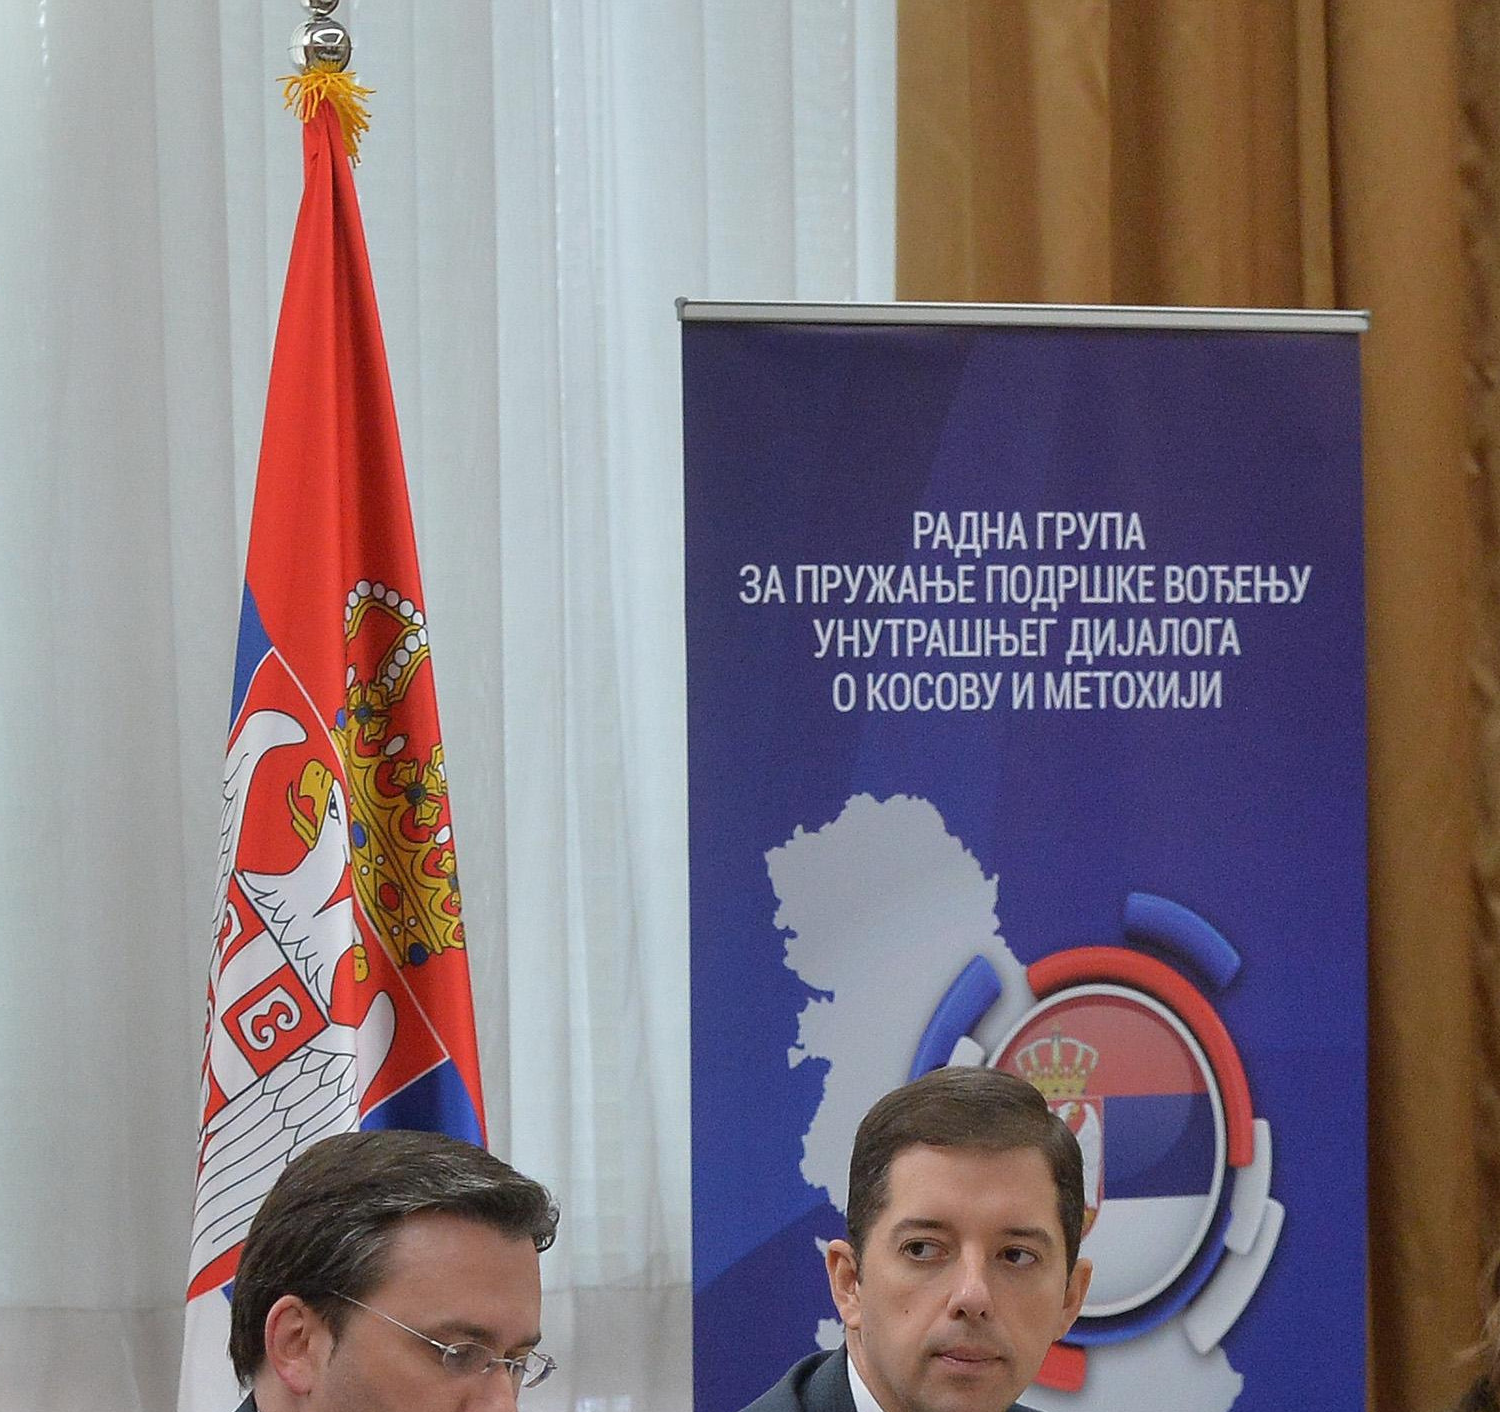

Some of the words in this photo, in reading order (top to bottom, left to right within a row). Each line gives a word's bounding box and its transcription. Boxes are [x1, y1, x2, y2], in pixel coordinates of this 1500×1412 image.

[914, 511, 1028, 558] РАДНА
[1037, 512, 1146, 550] ГРУПА
[739, 564, 786, 603] ЗА
[796, 565, 976, 604] ПРУЖАЊЕ
[986, 565, 1156, 612] ПОДРШКЕ
[1165, 565, 1311, 604] ВОЂЕЊУ
[813, 618, 1057, 658] УНУТРАШЊЕГ
[1066, 617, 1241, 665] ДИЈАЛОГА
[833, 672, 856, 712] О
[867, 672, 1002, 711] КОСОВУ
[1012, 672, 1034, 710] И
[1045, 671, 1222, 709] МЕТОХИЈИ
